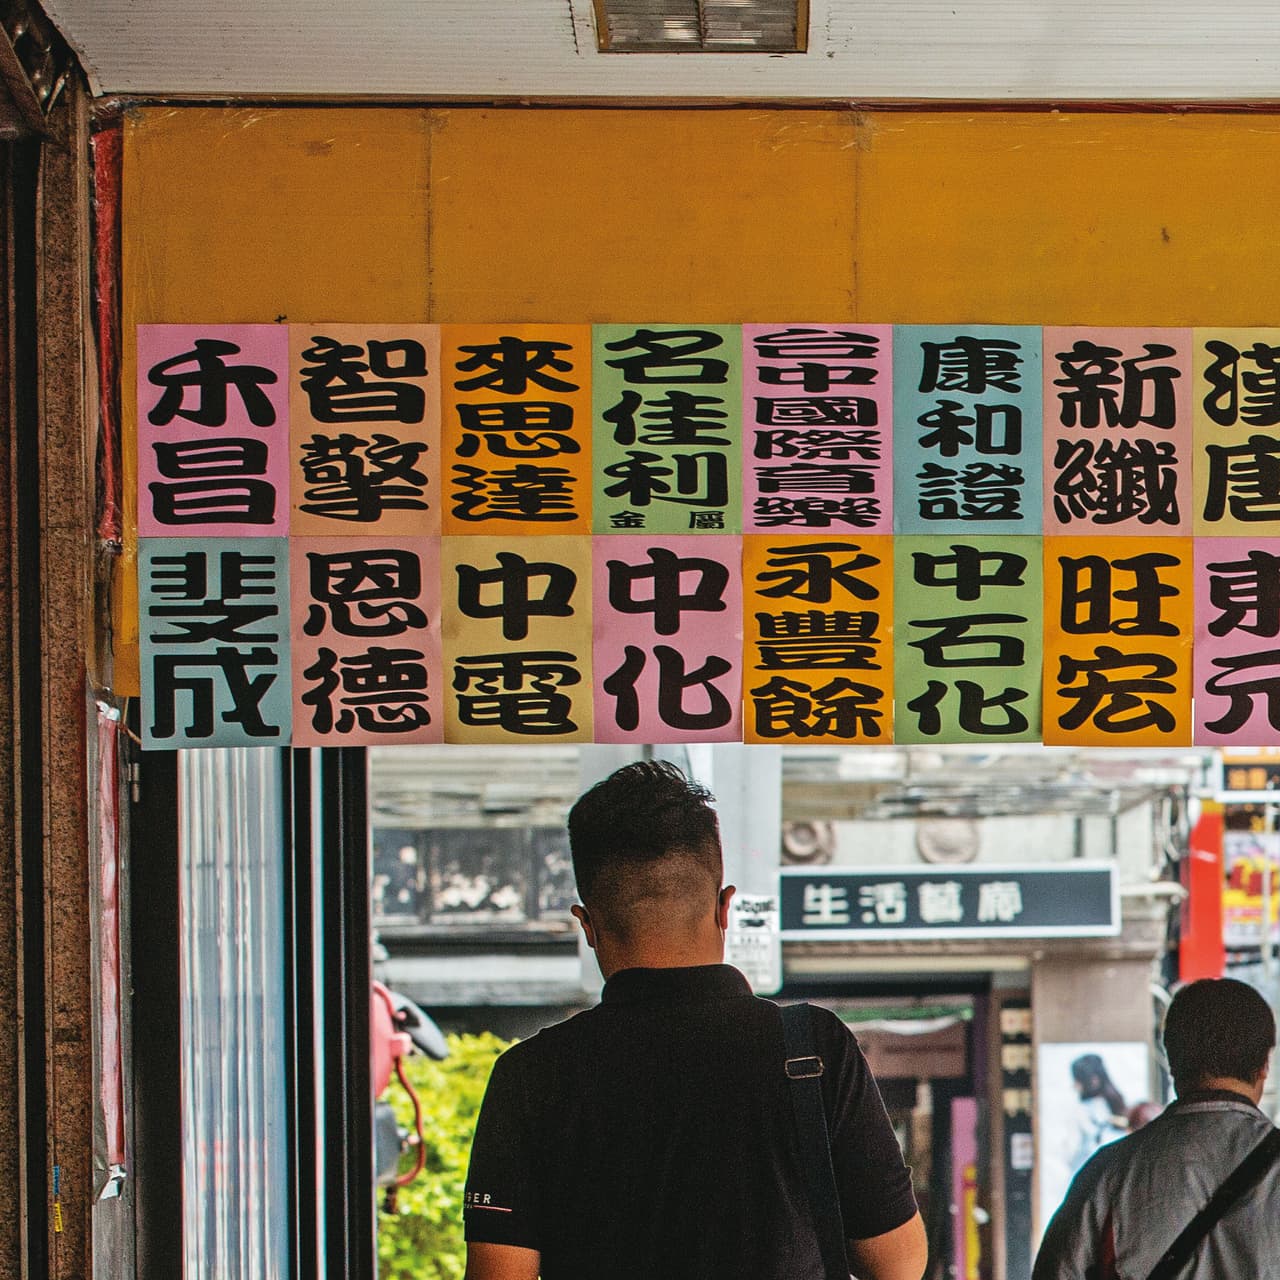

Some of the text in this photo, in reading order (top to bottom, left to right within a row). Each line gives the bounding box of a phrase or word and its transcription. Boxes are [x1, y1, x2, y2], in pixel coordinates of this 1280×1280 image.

[147, 338, 278, 526] 禾昌
[298, 335, 429, 523] 智擎
[450, 336, 581, 522] 來思達
[752, 328, 882, 528] 台中國際育樂
[914, 335, 1026, 521] 康和證
[1052, 340, 1182, 526] 新纖
[147, 551, 281, 739] 斐成
[301, 548, 432, 735] 恩德
[451, 551, 582, 736] 中電
[602, 547, 732, 732] 中化
[749, 542, 884, 739] 永豐餘
[906, 544, 1029, 736] 中石化
[1056, 552, 1181, 734] 旺宏
